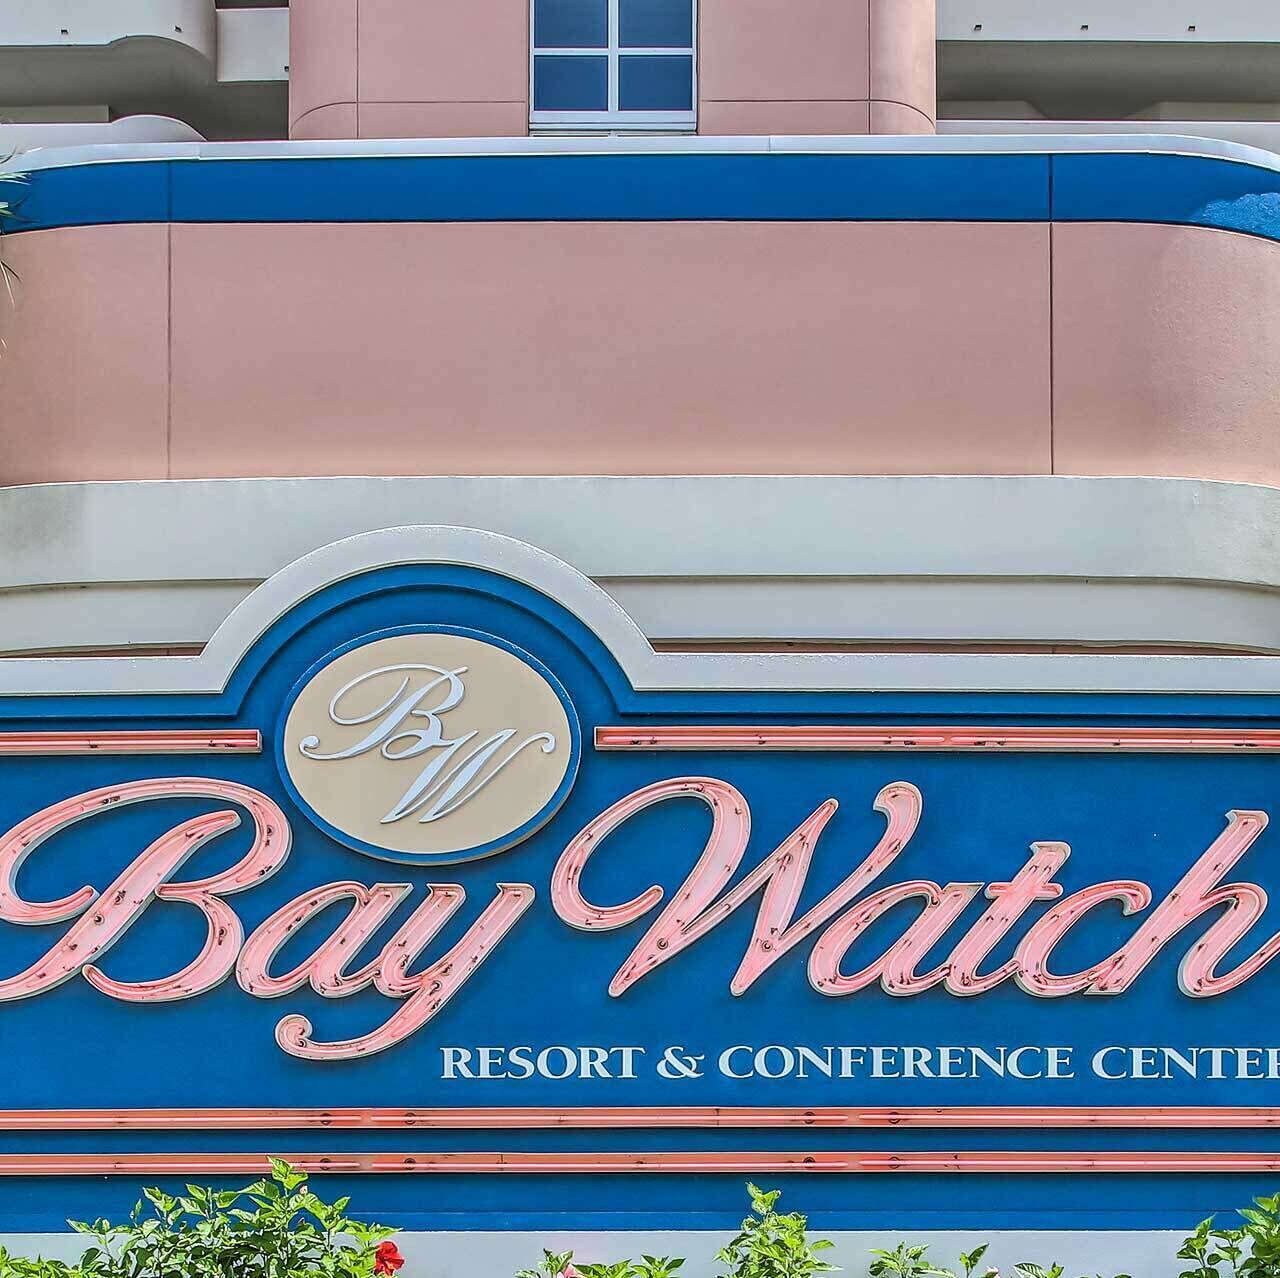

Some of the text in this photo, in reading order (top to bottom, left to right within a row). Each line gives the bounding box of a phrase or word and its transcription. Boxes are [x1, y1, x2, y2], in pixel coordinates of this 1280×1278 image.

[440, 1045, 645, 1080] RESORT
[656, 1045, 705, 1079] &
[718, 1044, 1075, 1079] CONFERENCE
